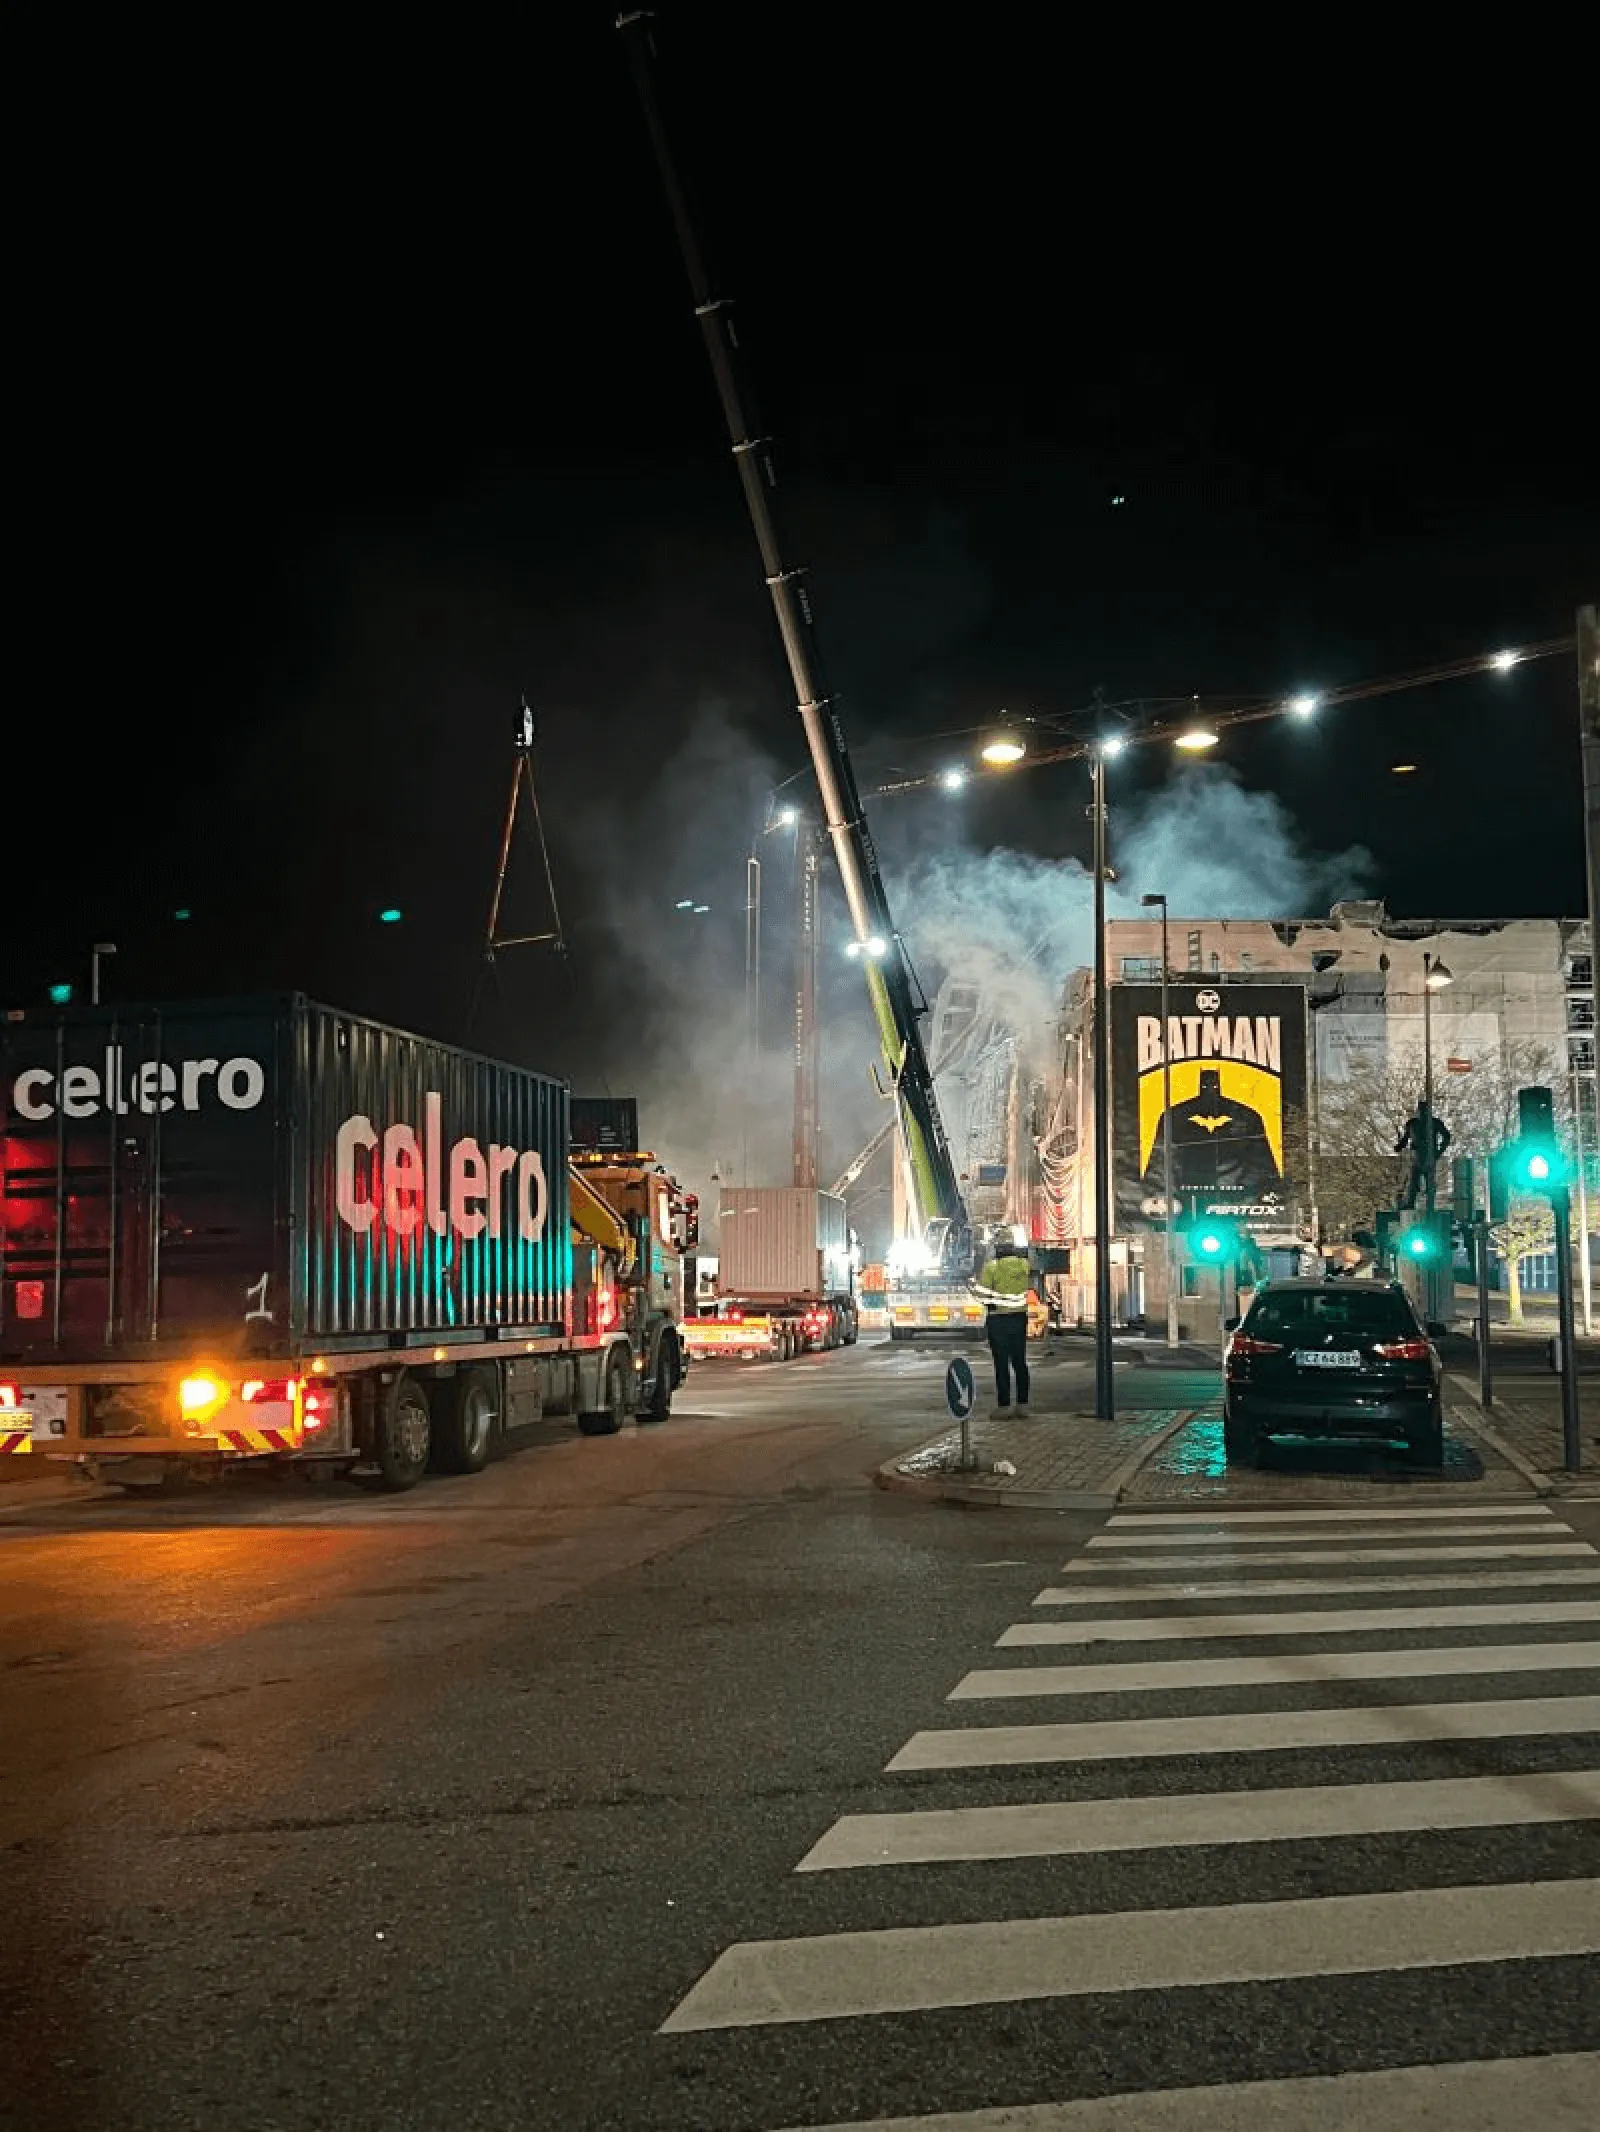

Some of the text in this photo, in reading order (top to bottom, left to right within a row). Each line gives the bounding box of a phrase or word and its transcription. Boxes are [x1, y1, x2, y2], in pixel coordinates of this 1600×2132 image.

[1197, 993, 1219, 1009] DC
[1137, 1016, 1282, 1073] BATMAN
[13, 1045, 265, 1121] celero
[335, 1091, 548, 1243] celero
[1205, 1205, 1284, 1215] AIRTOX
[245, 1271, 272, 1321] 1
